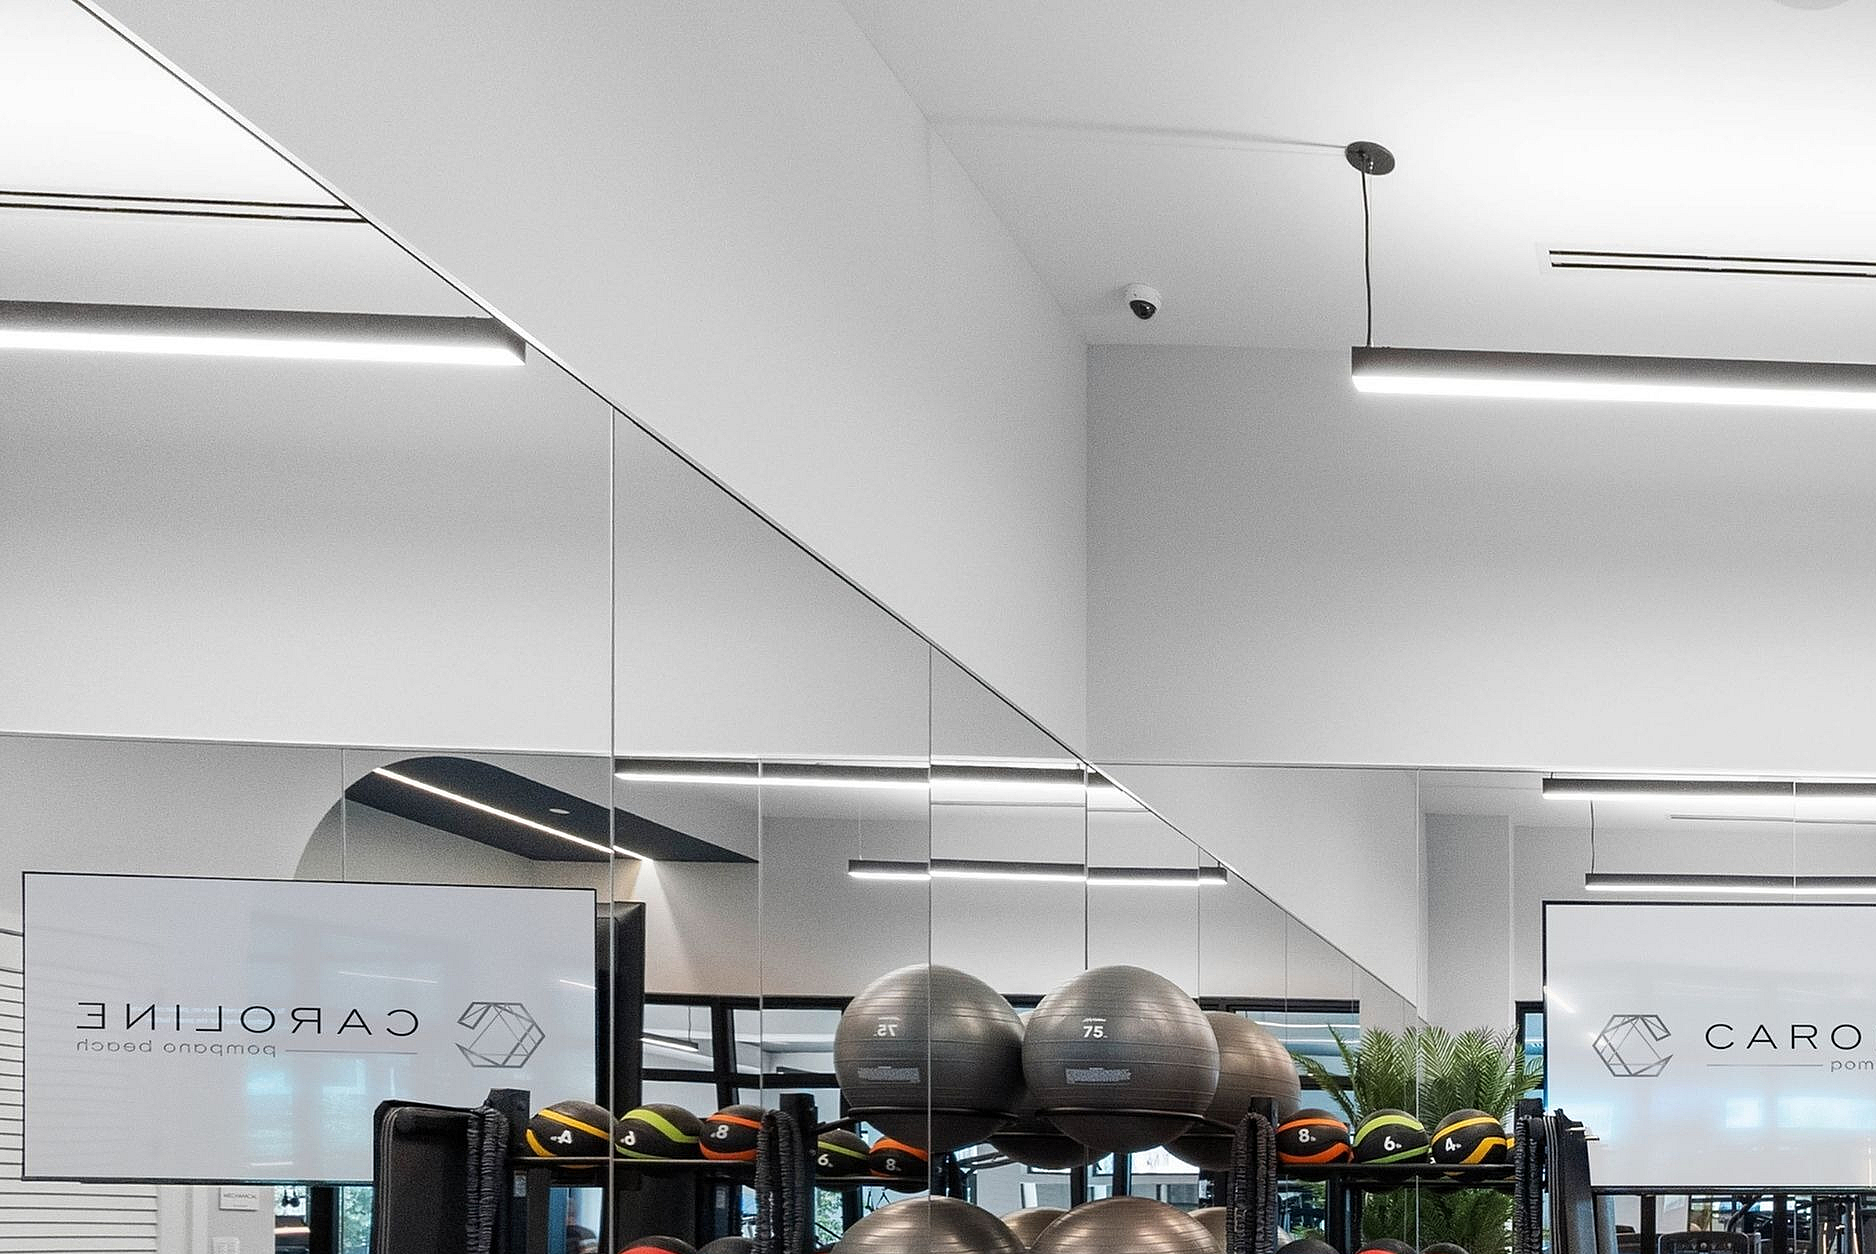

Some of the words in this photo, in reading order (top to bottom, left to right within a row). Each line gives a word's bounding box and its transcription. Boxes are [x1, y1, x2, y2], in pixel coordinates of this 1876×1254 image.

[1083, 1025, 1104, 1039] 75
[1298, 1128, 1310, 1143] 8
[1383, 1136, 1396, 1151] 6
